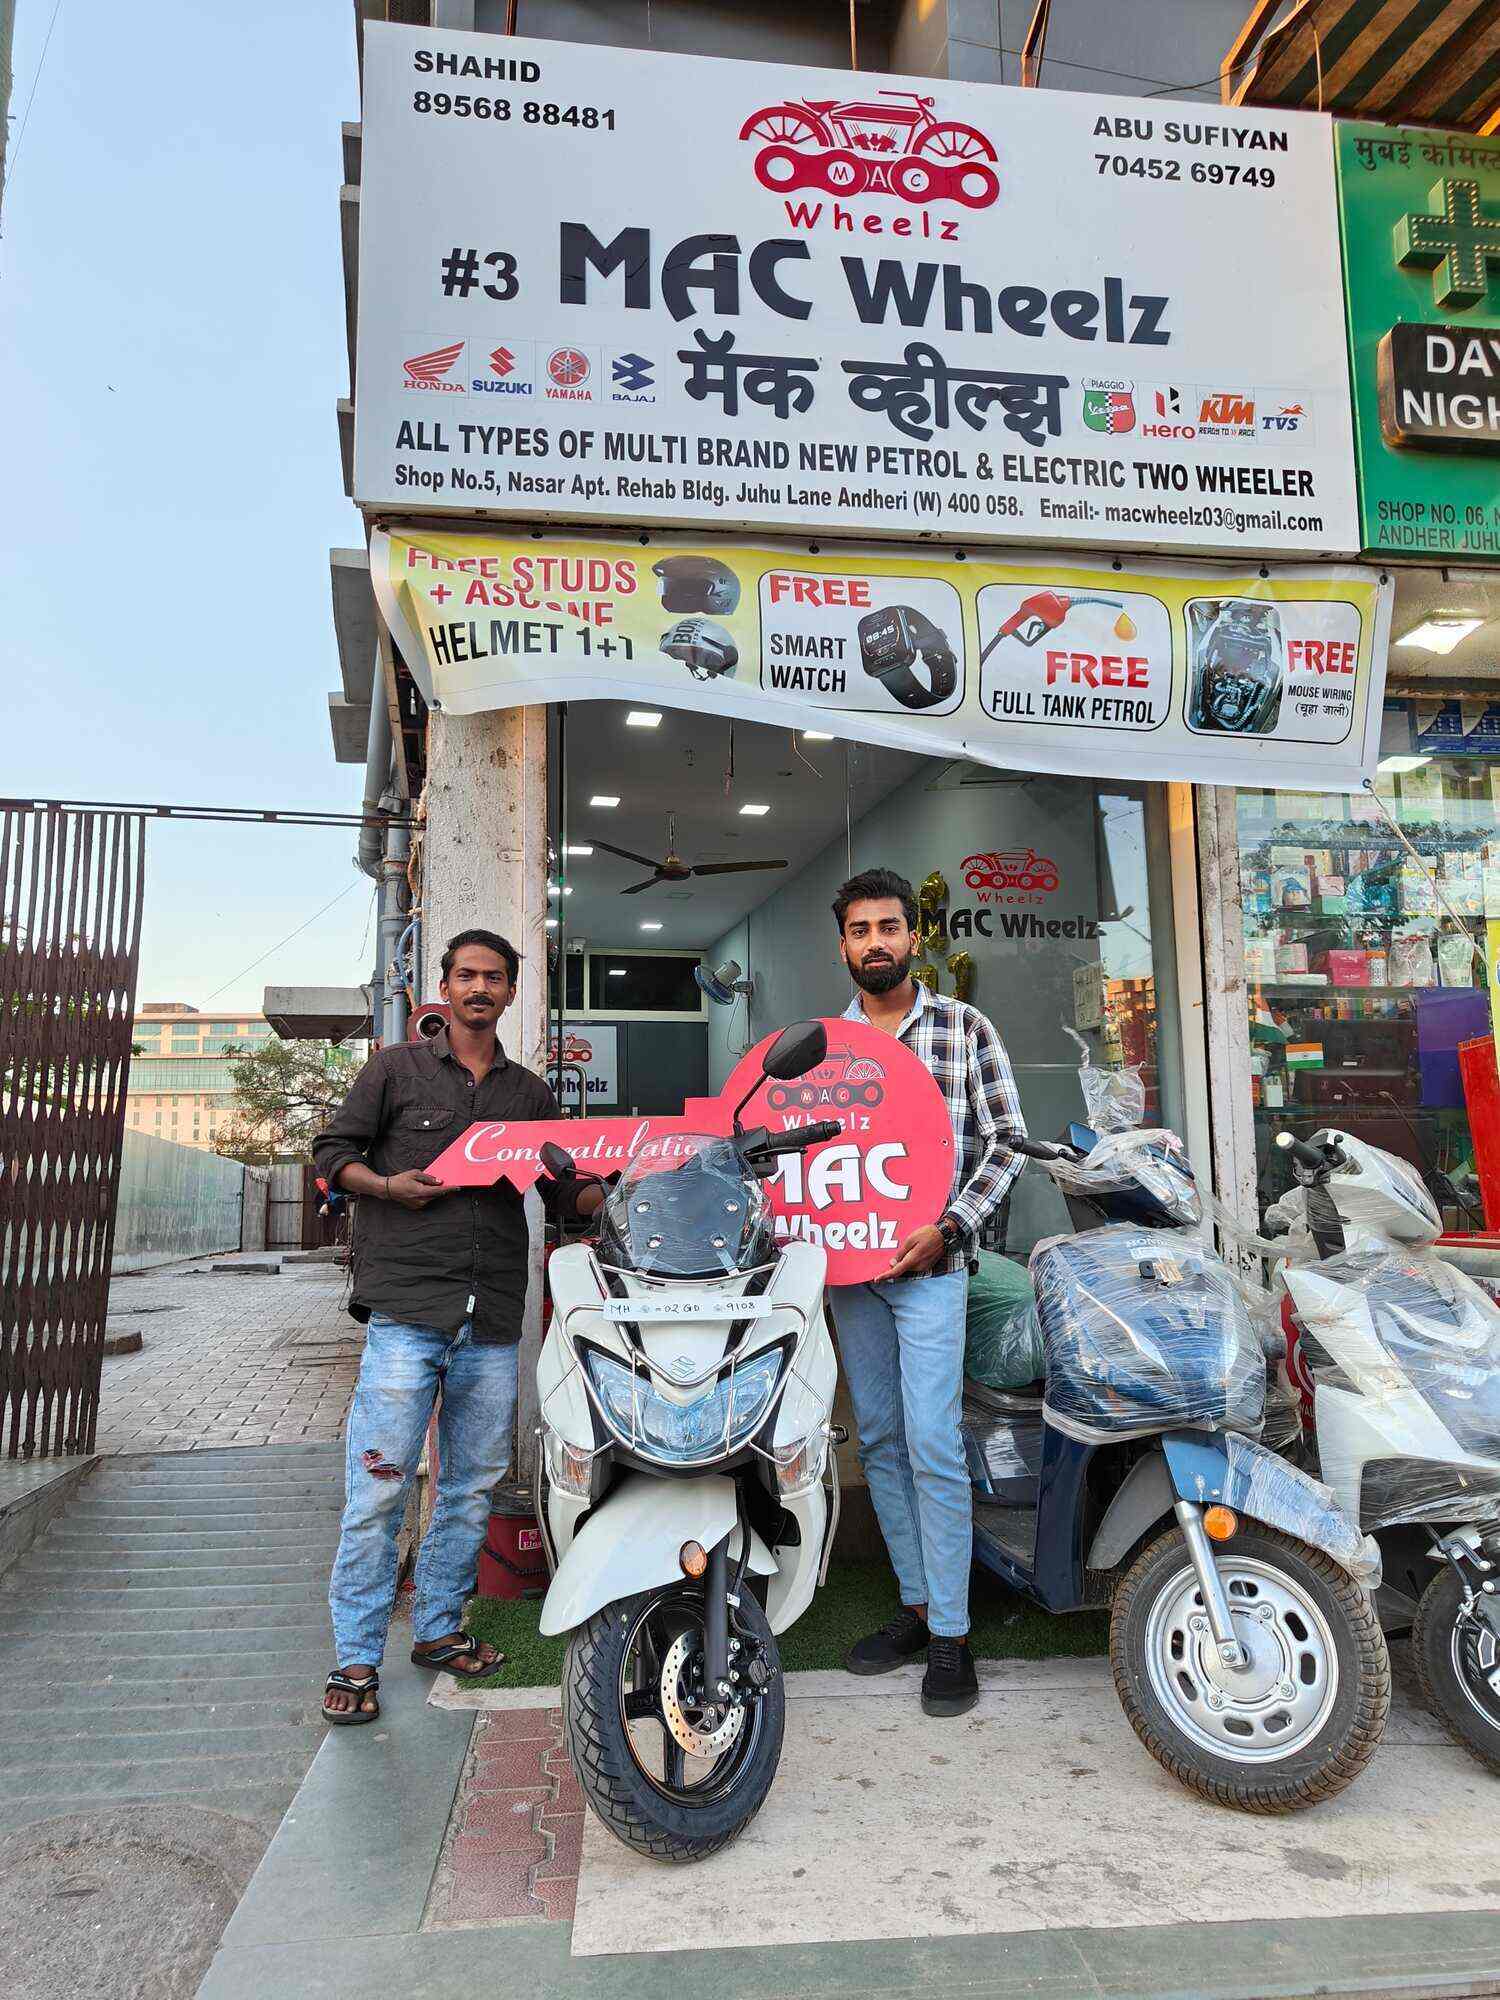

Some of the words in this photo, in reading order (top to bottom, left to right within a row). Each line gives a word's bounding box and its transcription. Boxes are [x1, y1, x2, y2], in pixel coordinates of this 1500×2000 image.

[413, 50, 541, 83] SHAHID
[412, 91, 512, 122] 89568
[523, 101, 616, 131] 88481
[1092, 115, 1156, 144] ABU
[1164, 122, 1289, 152] SUFIYAN
[832, 165, 922, 188] MAC
[1094, 154, 1182, 182] 70452
[1190, 161, 1276, 189] 69749
[784, 200, 959, 241] Wheelz
[440, 247, 518, 302] #3
[559, 221, 813, 323] MAC
[841, 256, 1172, 346] Wheelz
[402, 379, 465, 394] HONDA
[471, 379, 533, 396] SUZUKI
[544, 387, 593, 402] YAMAHA
[611, 393, 657, 404] BAJAJ
[1090, 379, 1126, 390] PIAGGIO
[1199, 393, 1256, 425] KTM
[1262, 416, 1298, 432] TVS
[1221, 427, 1230, 436] TO
[1238, 429, 1256, 437] RACE
[395, 420, 450, 453] ALL
[458, 424, 550, 459] TYPES
[558, 429, 595, 460] OF
[604, 432, 688, 465] MULTI
[697, 437, 791, 470] BRAND
[799, 442, 858, 473] NEW
[866, 445, 967, 479] PETROL
[976, 452, 994, 481] &
[1003, 454, 1126, 489] ELECTRIC
[1132, 462, 1189, 492] TWO
[1196, 465, 1316, 498] WHEELER
[395, 464, 444, 495] Shop
[451, 468, 502, 498] No.5,
[508, 472, 566, 495] Nasar
[571, 474, 610, 504] Apt.
[617, 476, 677, 501] Rehab
[683, 479, 730, 508] Bldg.
[736, 483, 782, 506] Juhu
[787, 485, 832, 507] Lane
[837, 487, 908, 512] Andheri
[913, 492, 943, 517] (W)
[947, 494, 982, 515] 400
[985, 496, 1025, 517] 058.
[1040, 498, 1100, 522] Email:-
[1104, 504, 1324, 533] macwheelz03@gmail.com
[1377, 500, 1425, 523] SHOP
[1430, 503, 1460, 525] NO.
[1378, 524, 1456, 549] ANDHERI
[513, 556, 638, 595] STUDS
[768, 574, 872, 608] FREE
[429, 620, 565, 666] HELMET
[576, 627, 634, 661] 1+1
[769, 633, 848, 661] SMART
[865, 624, 896, 644] 08:45
[1045, 650, 1150, 689] FREE
[1286, 640, 1356, 679] FREE
[769, 664, 847, 693] WATCH
[1287, 684, 1320, 698] MOUSE
[1322, 687, 1353, 701] WIRING
[992, 690, 1036, 716] FULL
[1041, 693, 1086, 720] TANK
[1090, 699, 1157, 725] PETROL
[976, 891, 1044, 905] Wheelz
[920, 908, 993, 940] MAC
[1000, 911, 1098, 940] Wheelz
[609, 1304, 631, 1314] MH
